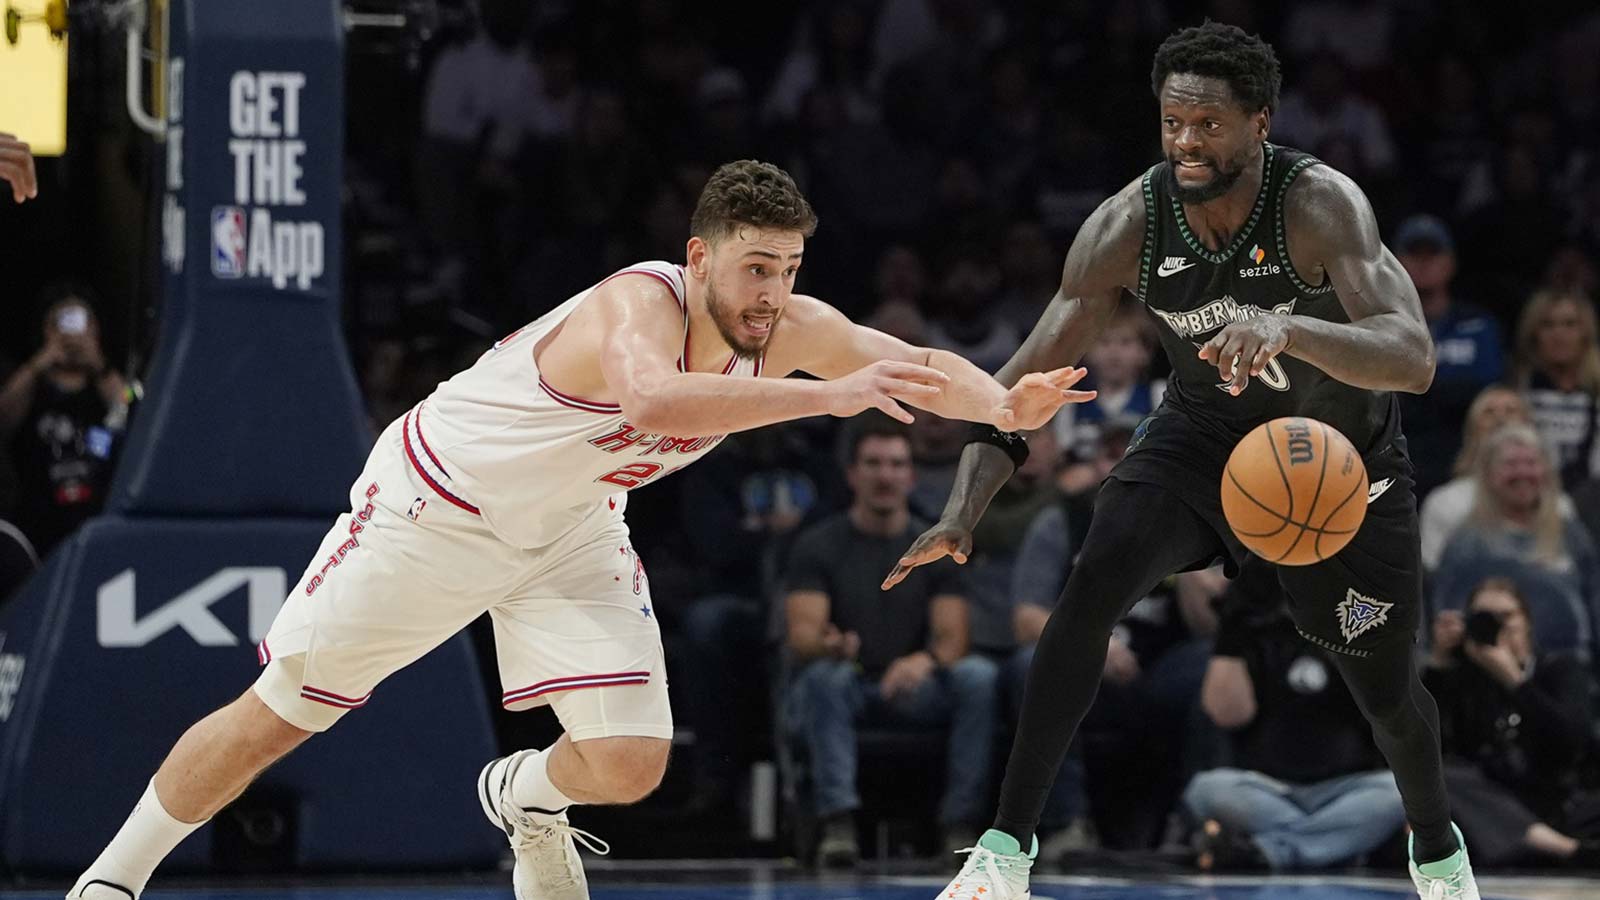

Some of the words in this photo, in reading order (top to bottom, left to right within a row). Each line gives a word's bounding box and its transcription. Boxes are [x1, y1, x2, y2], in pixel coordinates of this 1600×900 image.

[229, 70, 306, 137] GET
[228, 139, 306, 205] THE
[247, 207, 325, 289] App
[1163, 256, 1187, 269] NIKE
[1239, 263, 1280, 278] sezzle
[1368, 477, 1390, 495] NIKE
